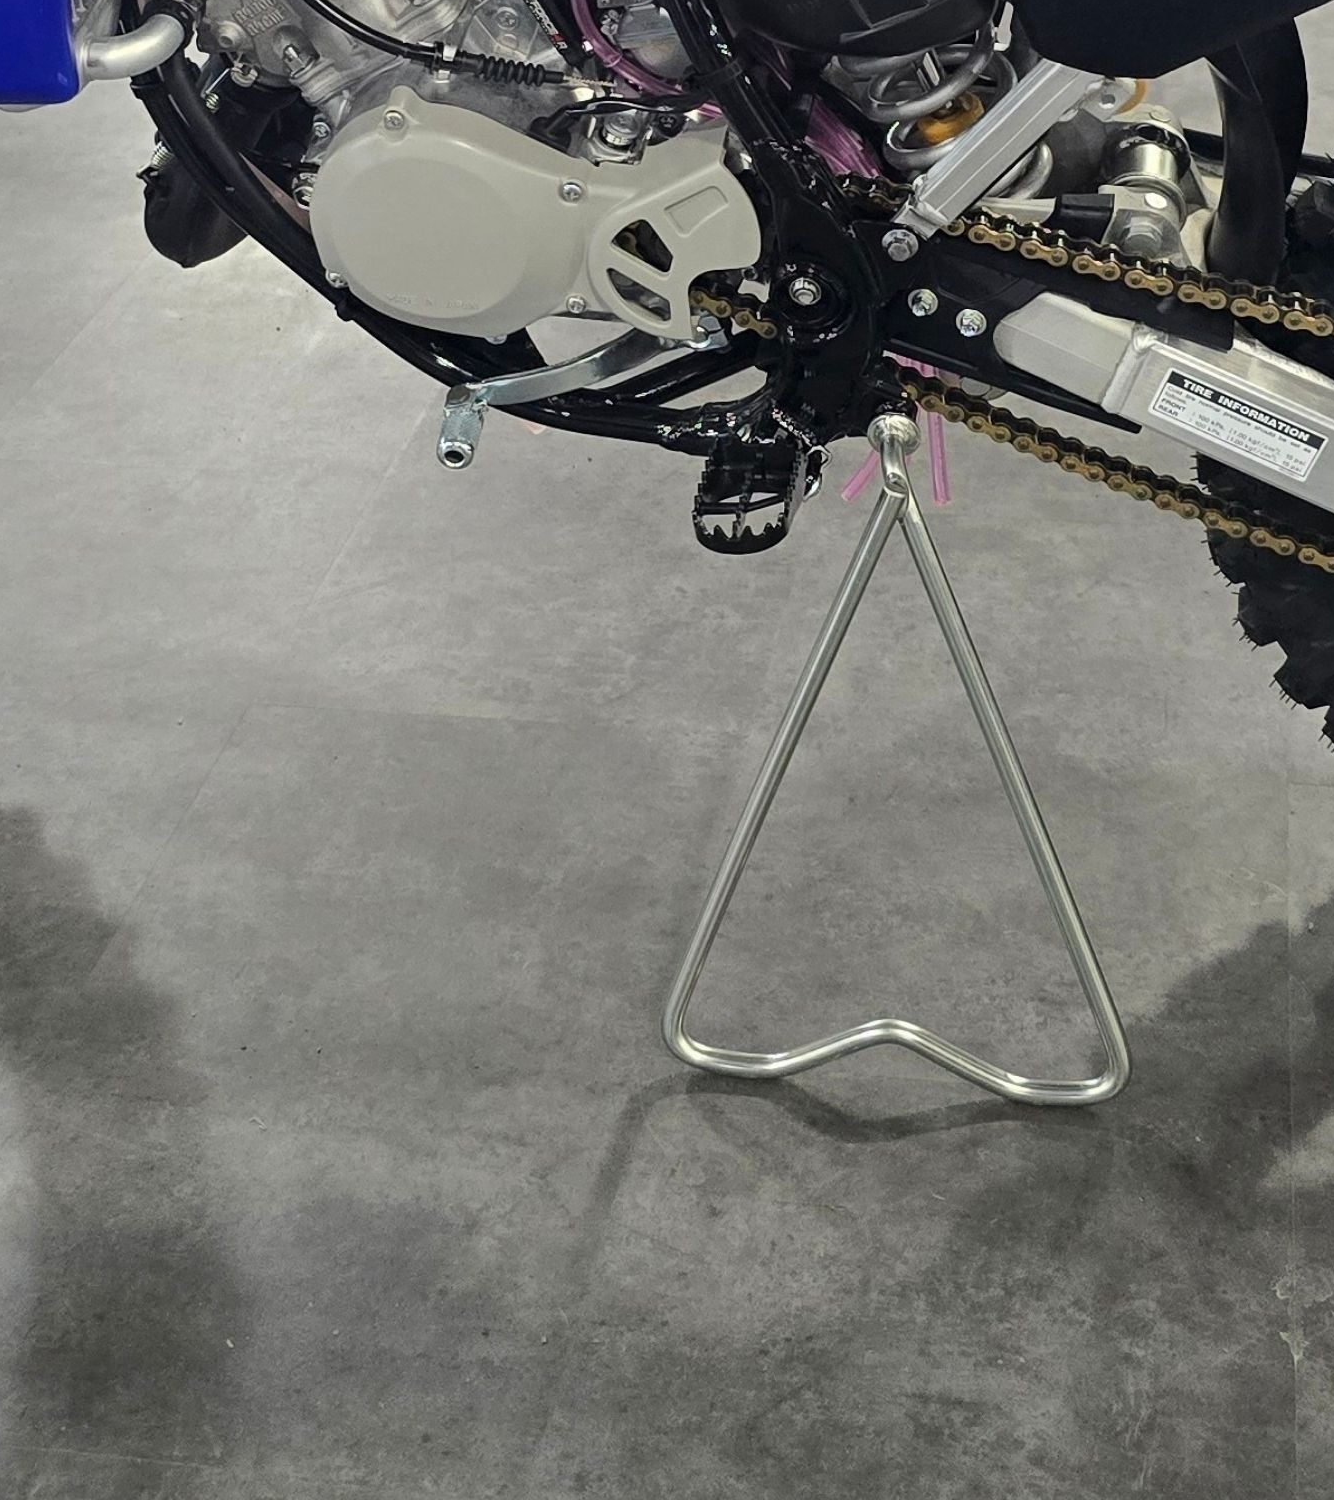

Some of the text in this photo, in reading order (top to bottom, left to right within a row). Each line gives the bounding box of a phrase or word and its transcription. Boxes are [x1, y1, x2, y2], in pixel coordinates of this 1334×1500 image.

[1158, 405, 1179, 417] REAR
[1161, 398, 1186, 412] FRONT
[1183, 379, 1310, 441] TIRE INFORMATION
